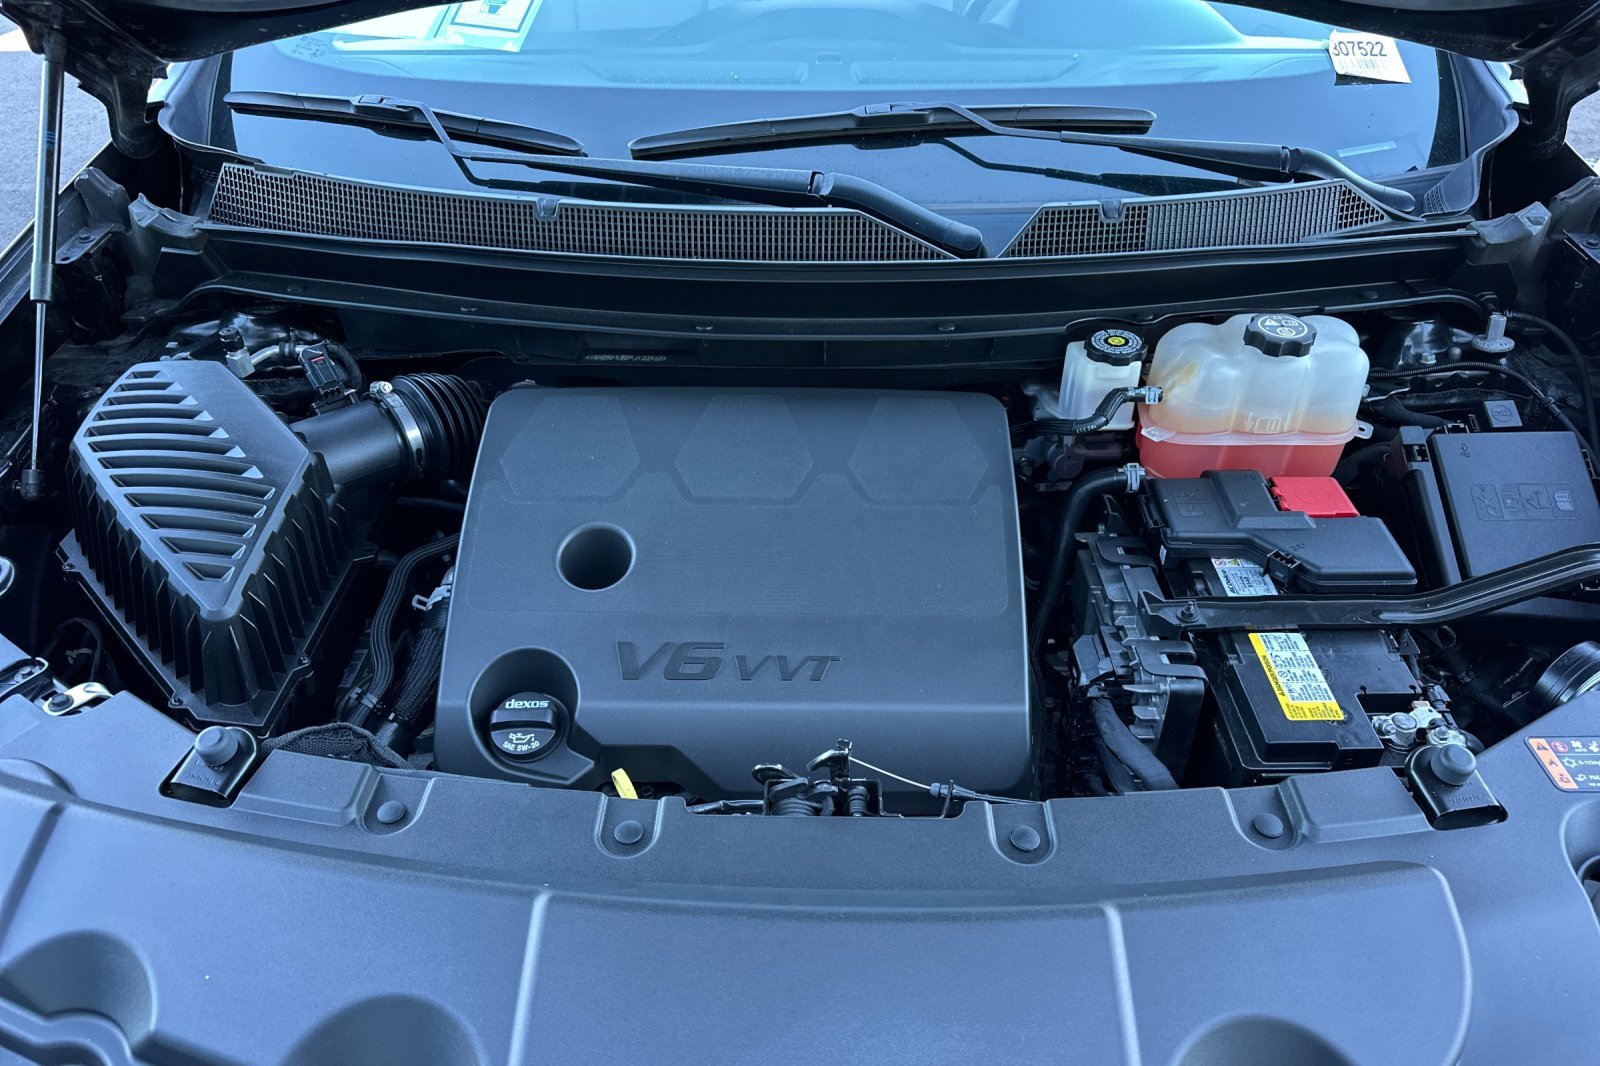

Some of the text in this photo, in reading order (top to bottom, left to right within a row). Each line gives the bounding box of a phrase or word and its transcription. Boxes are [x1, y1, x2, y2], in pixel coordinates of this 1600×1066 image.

[616, 641, 842, 681] V6 VVT
[505, 699, 550, 709] dexos
[502, 740, 540, 752] SAE 5W-30
